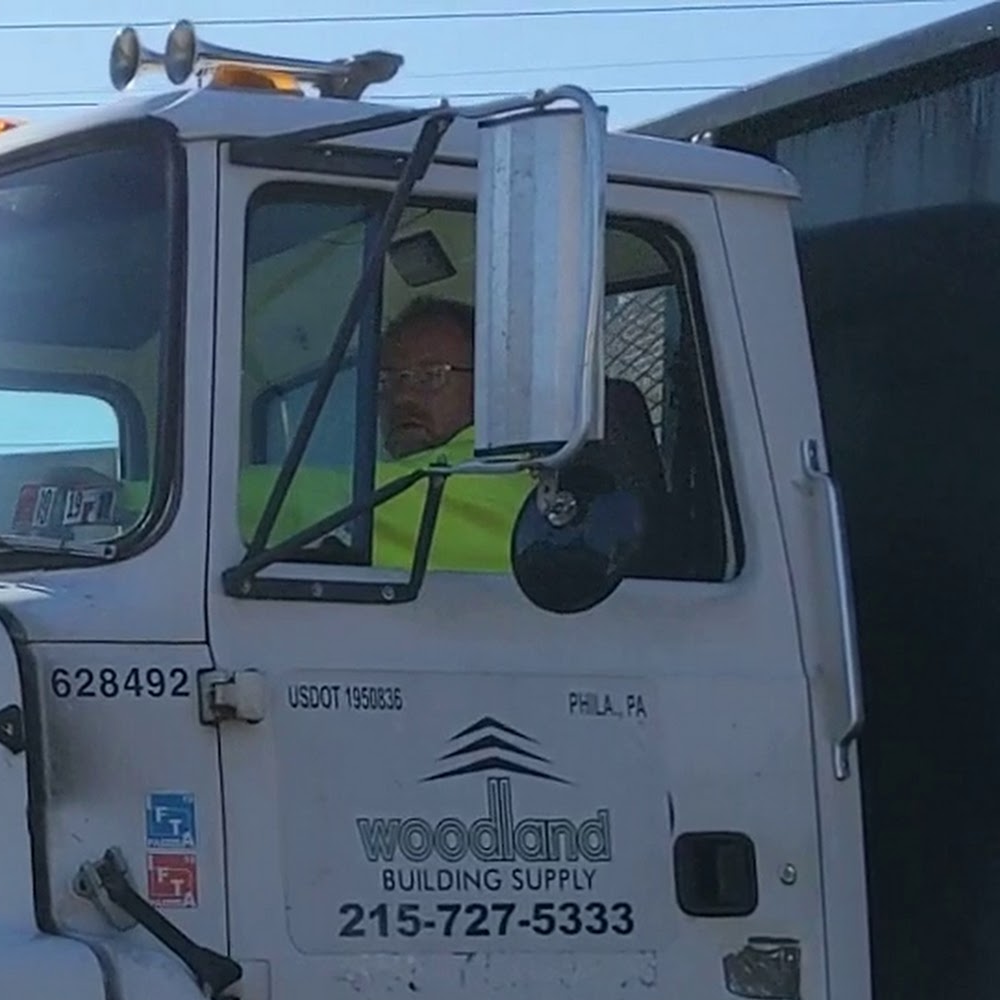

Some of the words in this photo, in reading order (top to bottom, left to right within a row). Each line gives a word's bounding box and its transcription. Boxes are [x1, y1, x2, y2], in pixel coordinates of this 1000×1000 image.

[51, 667, 190, 698] 628492
[288, 686, 340, 709] USDOT
[627, 695, 647, 717] PA
[356, 776, 612, 862] woodland
[382, 868, 502, 892] BUILDING
[512, 868, 598, 891] SUPPLY
[338, 902, 635, 938] 215-727-5333
